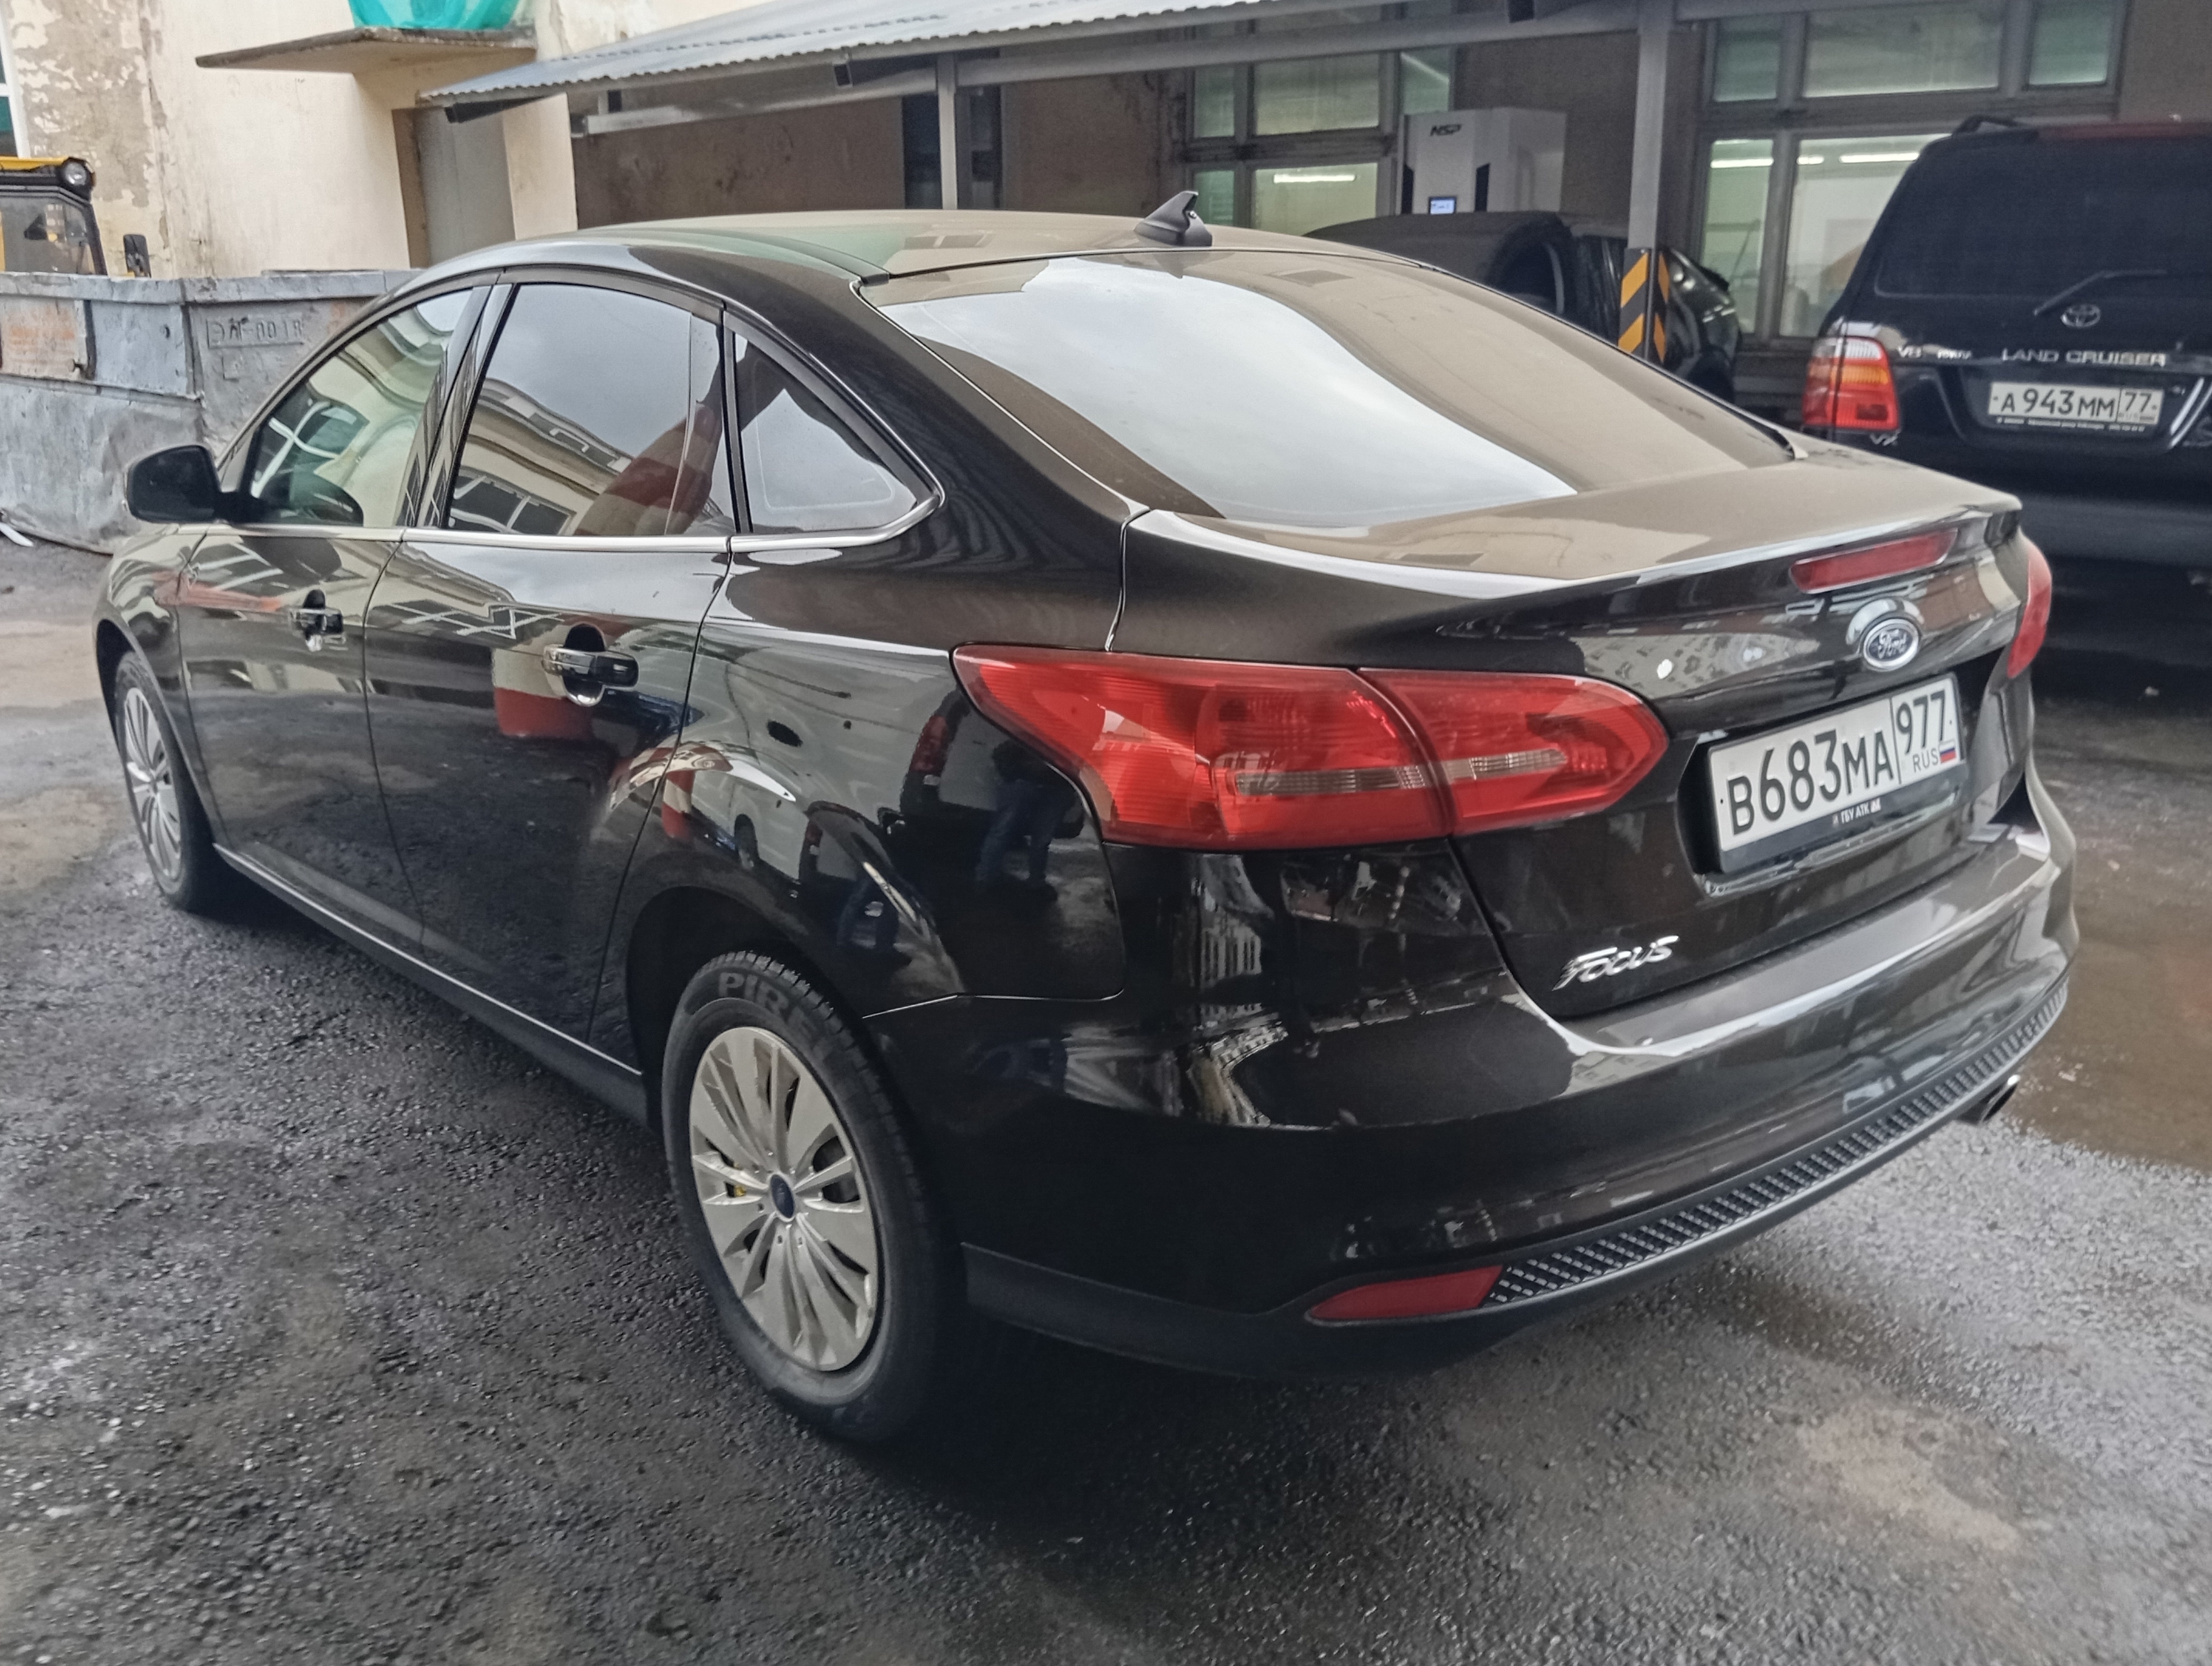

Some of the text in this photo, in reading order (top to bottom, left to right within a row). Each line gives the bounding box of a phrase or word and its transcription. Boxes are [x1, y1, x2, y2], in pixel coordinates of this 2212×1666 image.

[2002, 348, 2167, 368] LAND CRUISER
[2124, 391, 2153, 413] 77
[1896, 690, 1946, 755] 977
[1913, 748, 1939, 772] RUS
